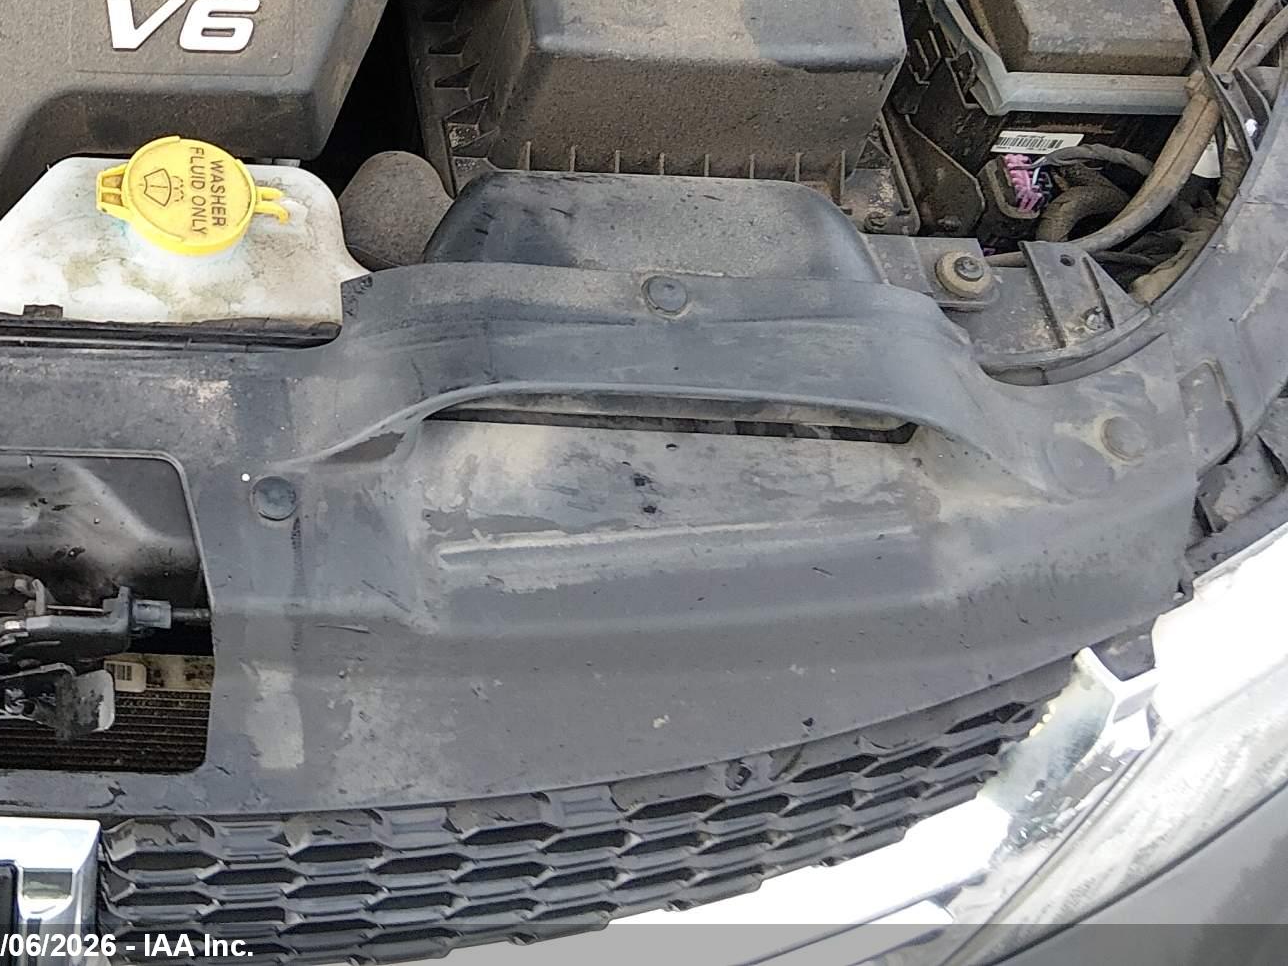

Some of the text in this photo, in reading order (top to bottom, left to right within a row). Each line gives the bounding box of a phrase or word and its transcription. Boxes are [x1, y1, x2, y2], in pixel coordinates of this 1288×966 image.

[189, 147, 207, 235] FLUID ONLY
[210, 160, 227, 226] WASHER
